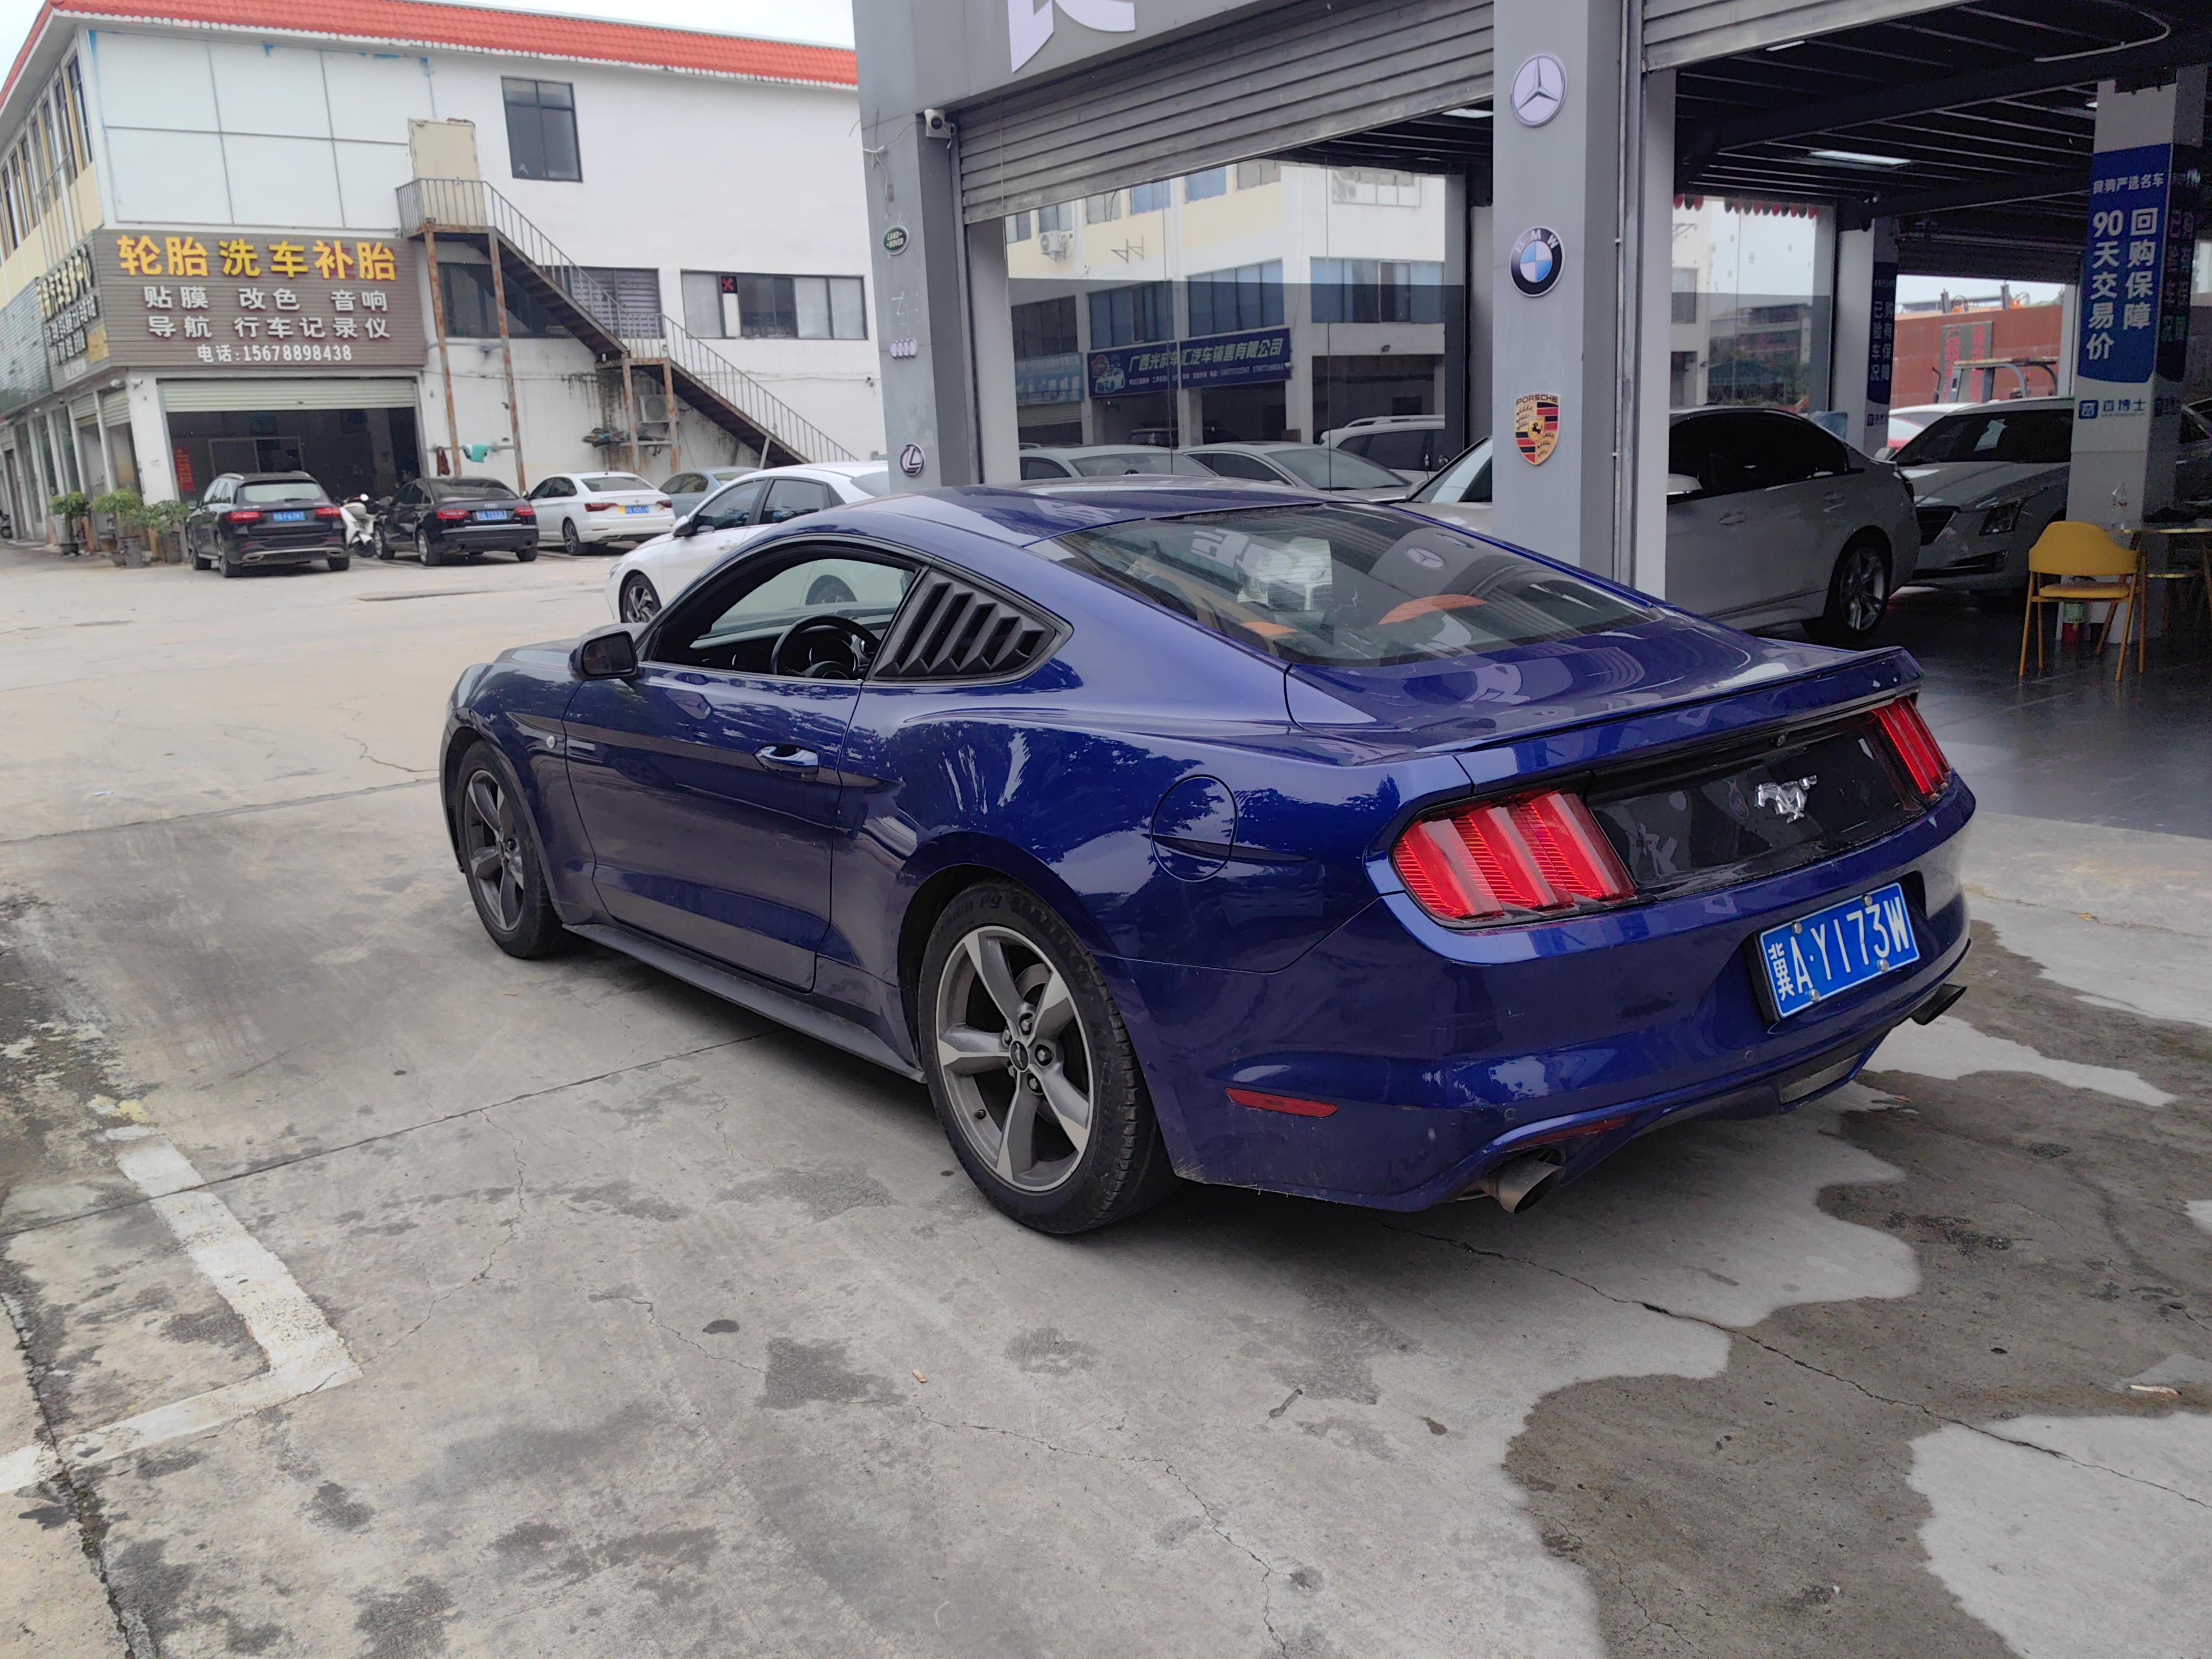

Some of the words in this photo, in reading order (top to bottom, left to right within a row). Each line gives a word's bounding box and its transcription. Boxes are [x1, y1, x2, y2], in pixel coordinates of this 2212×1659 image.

[887, 231, 899, 241] LAND
[889, 237, 903, 248] ROVER
[1515, 228, 1559, 254] BMW
[2123, 207, 2159, 330] 回购保障
[2086, 208, 2123, 360] 90天交易价
[144, 286, 210, 310] 贴膜
[238, 287, 300, 312] 改色
[330, 289, 388, 313] 音响
[148, 315, 213, 339] 导航
[233, 316, 391, 340] 行车记录仪
[1516, 394, 1558, 406] PORSCHE
